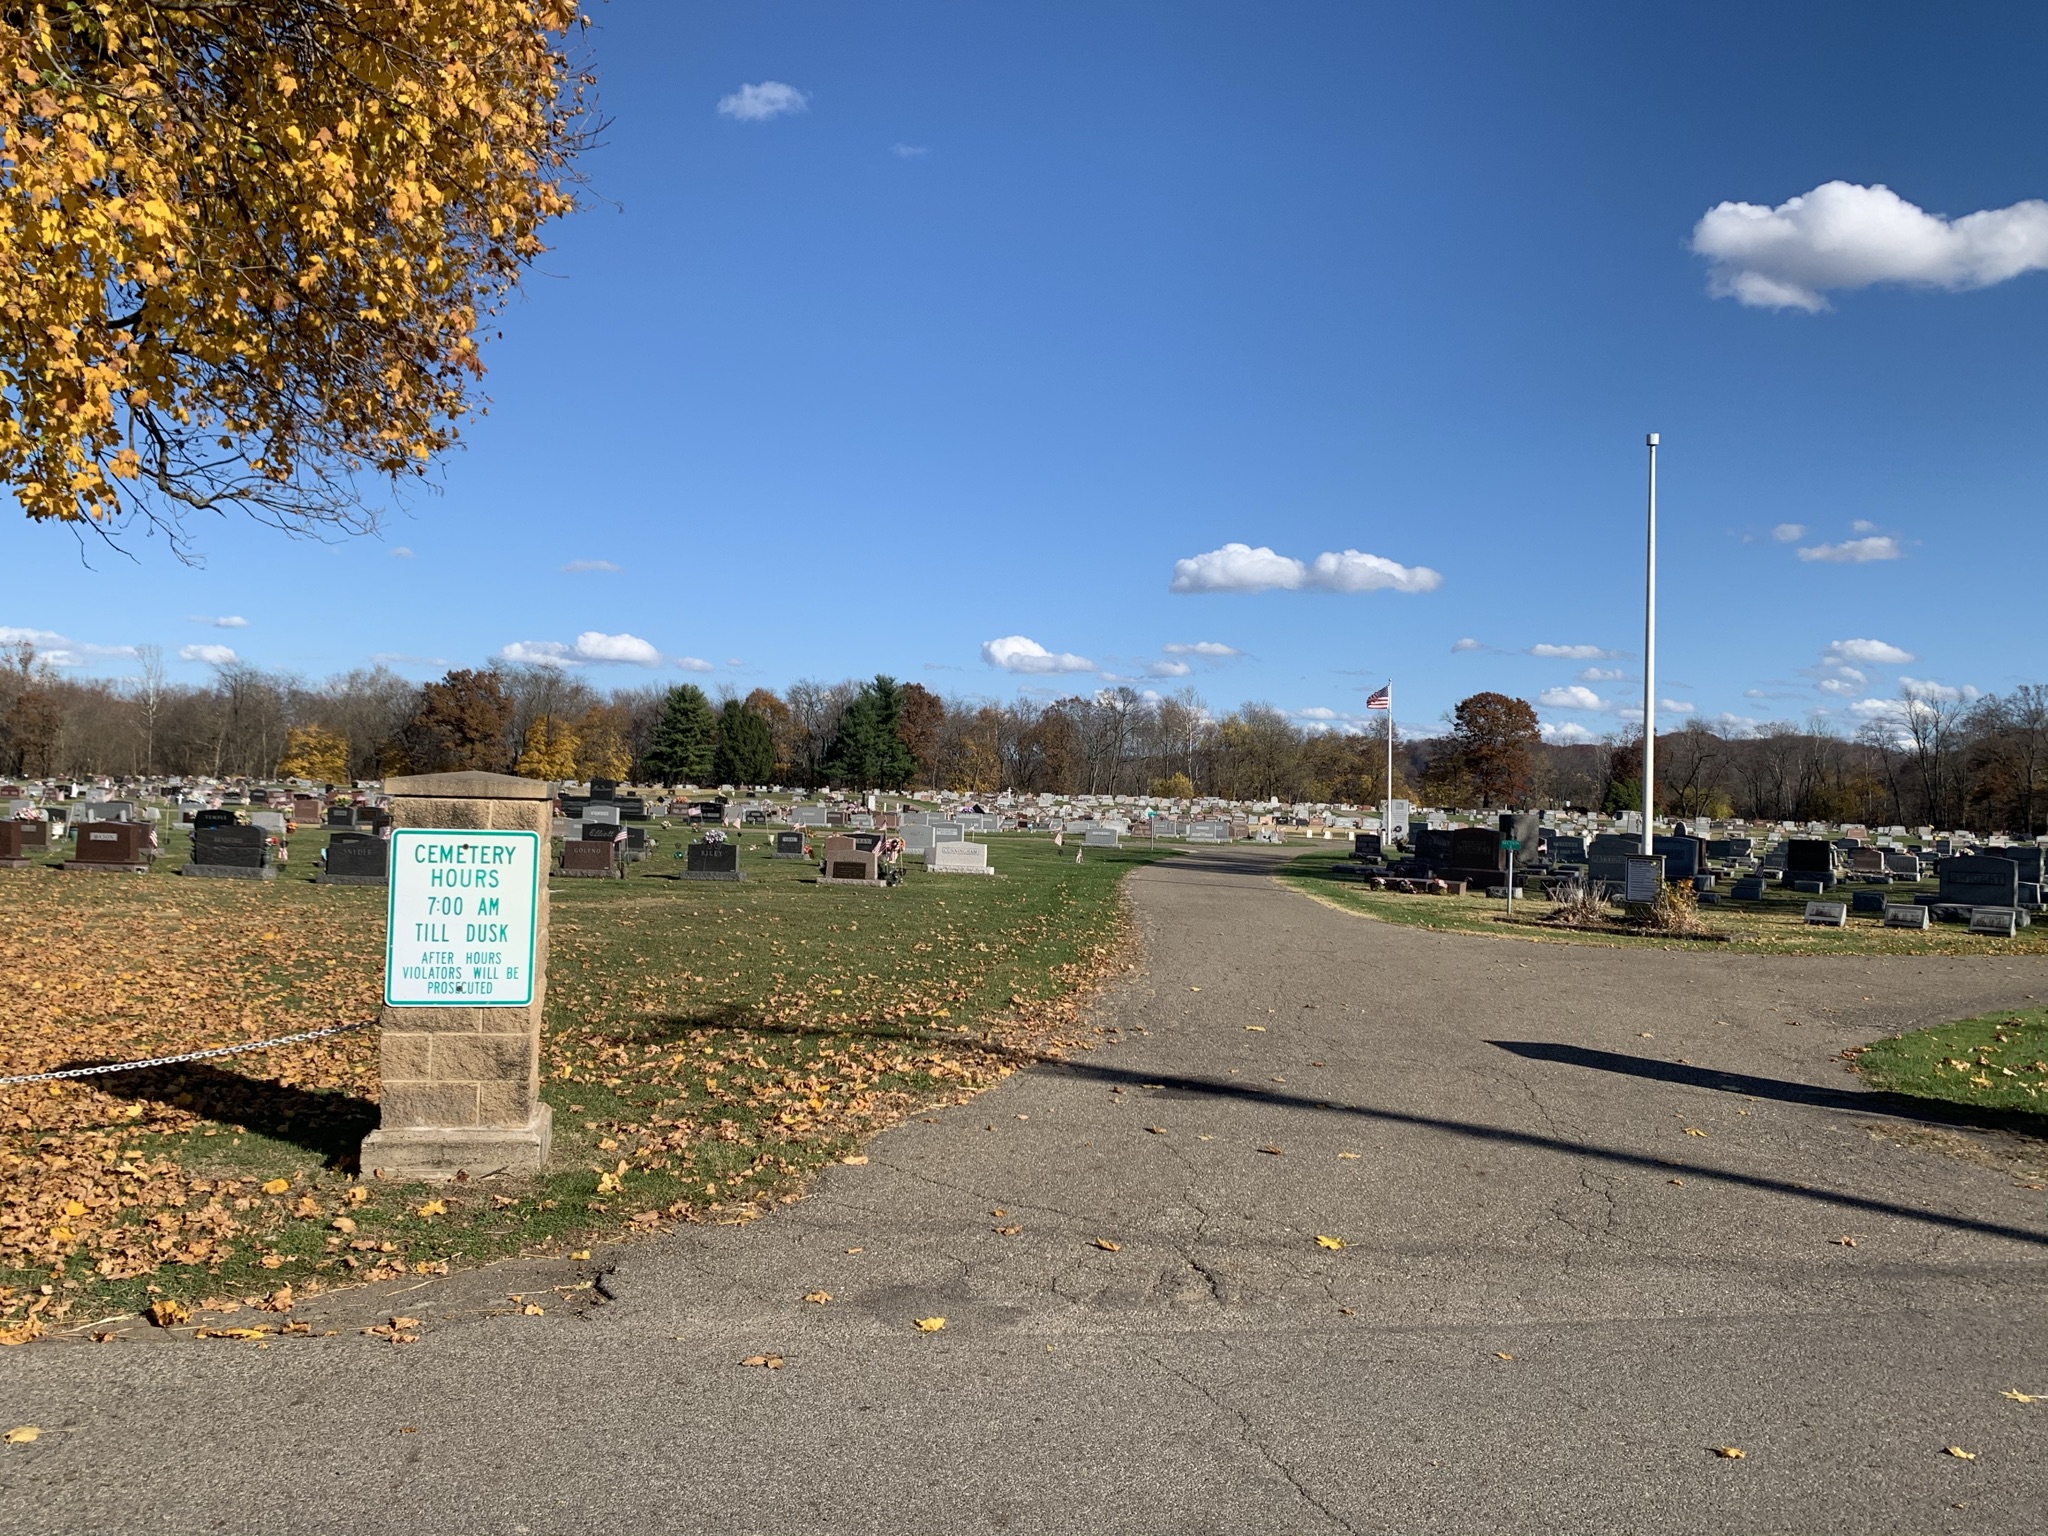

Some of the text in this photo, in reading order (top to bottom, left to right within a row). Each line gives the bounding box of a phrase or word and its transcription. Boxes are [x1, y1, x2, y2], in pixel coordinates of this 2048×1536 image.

[415, 844, 516, 864] CEMETERY
[431, 868, 500, 888] HOURS
[428, 896, 499, 916] 7:00 AM
[416, 923, 509, 943] TILL DUSK
[421, 952, 502, 965] AFTER HOURS
[403, 966, 520, 980] VIOLATORS WILL BE
[427, 981, 493, 994] PROSECUTED
